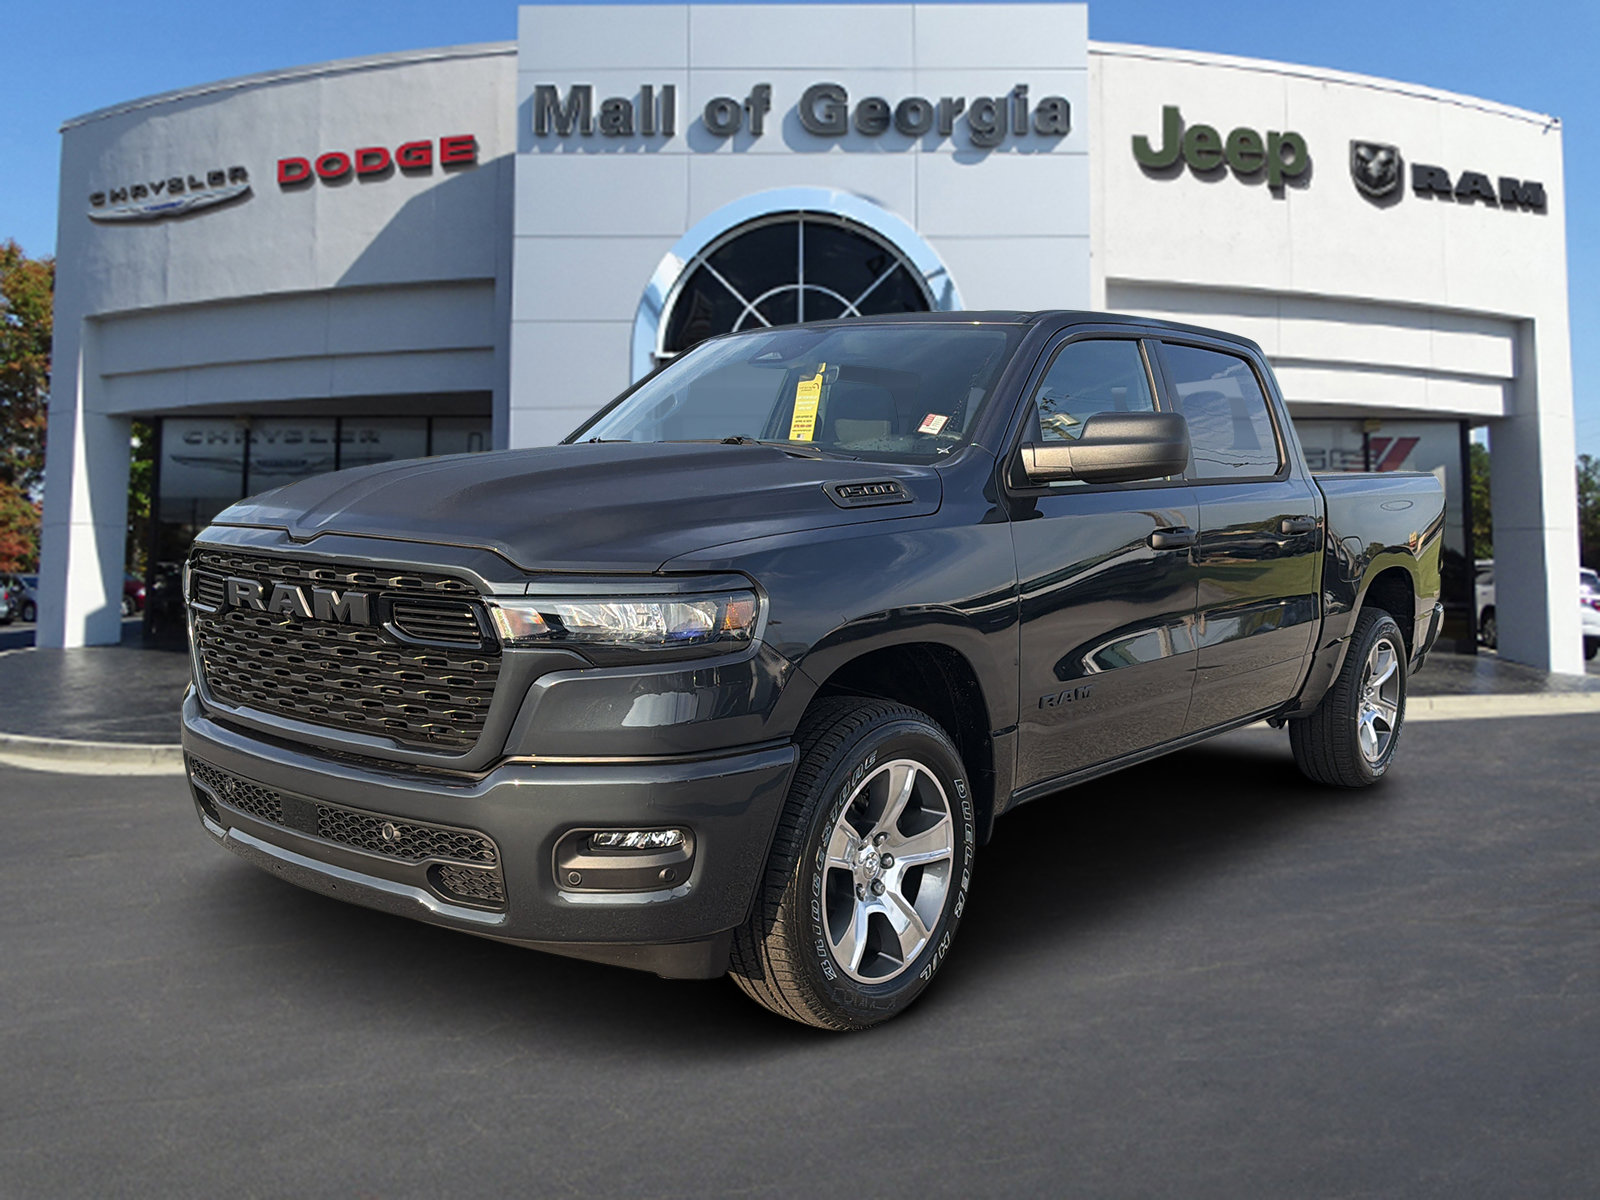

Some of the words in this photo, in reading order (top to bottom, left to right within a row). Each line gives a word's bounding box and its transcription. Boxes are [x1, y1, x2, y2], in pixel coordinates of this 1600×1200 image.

[533, 84, 676, 137] Mall
[703, 82, 772, 137] of
[800, 82, 1071, 147] Georgia
[277, 134, 476, 186] DODGE
[1132, 104, 1308, 190] Jeep
[89, 166, 249, 207] CHRYSLER
[1411, 162, 1547, 214] RAM
[837, 482, 901, 498] 1500
[226, 575, 370, 626] RAM
[1038, 683, 1095, 709] RAM
[811, 750, 878, 982] BRIDGESTONE
[953, 777, 976, 920] DUELER
